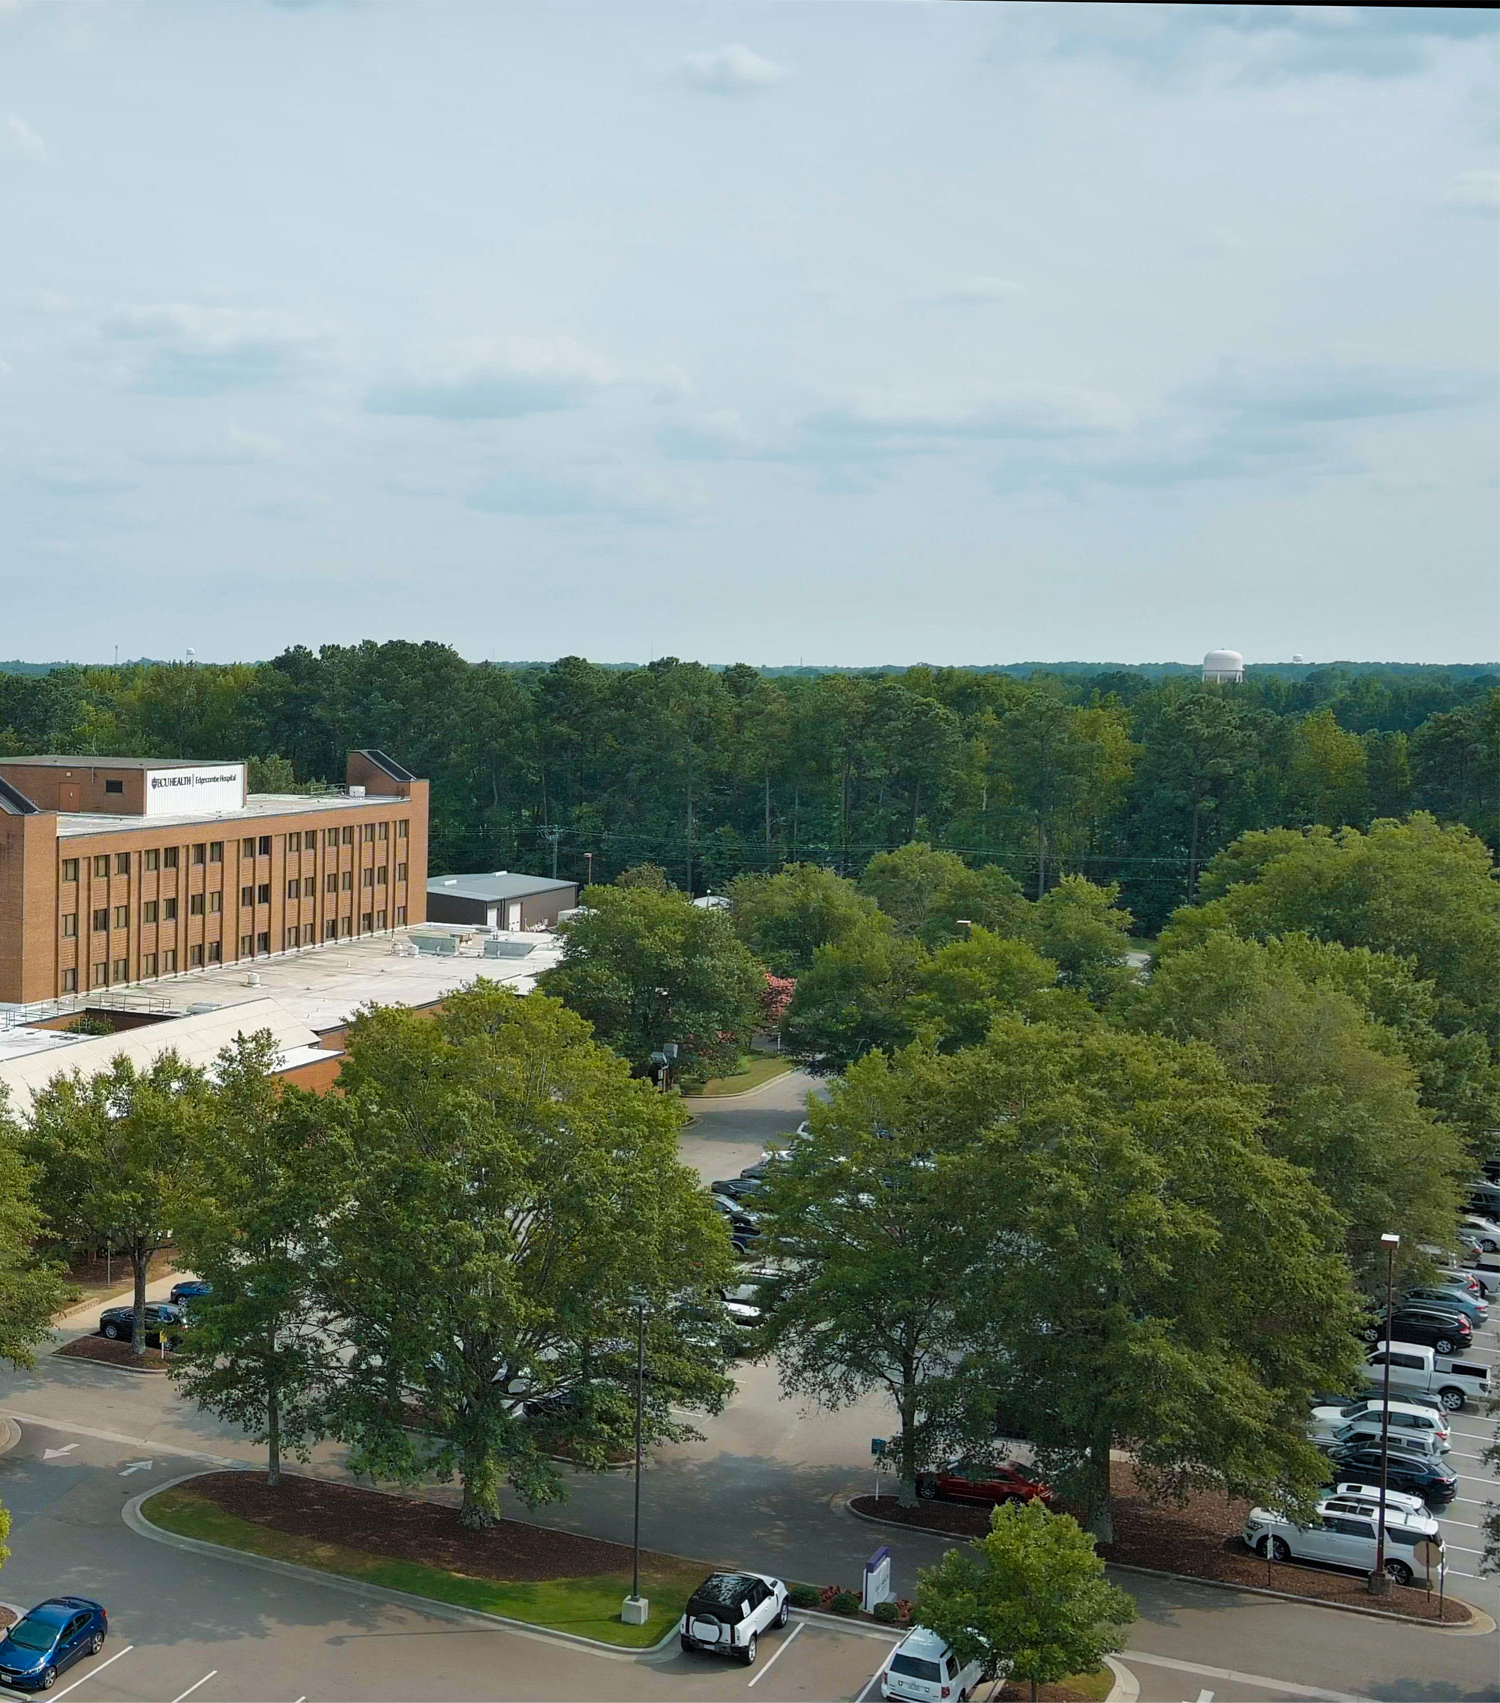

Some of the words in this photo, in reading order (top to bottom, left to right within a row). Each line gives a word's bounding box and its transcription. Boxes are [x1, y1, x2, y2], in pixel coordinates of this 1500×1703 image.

[157, 777, 169, 788] ECU
[169, 776, 191, 787] HEALTH
[220, 773, 236, 783] Hospital
